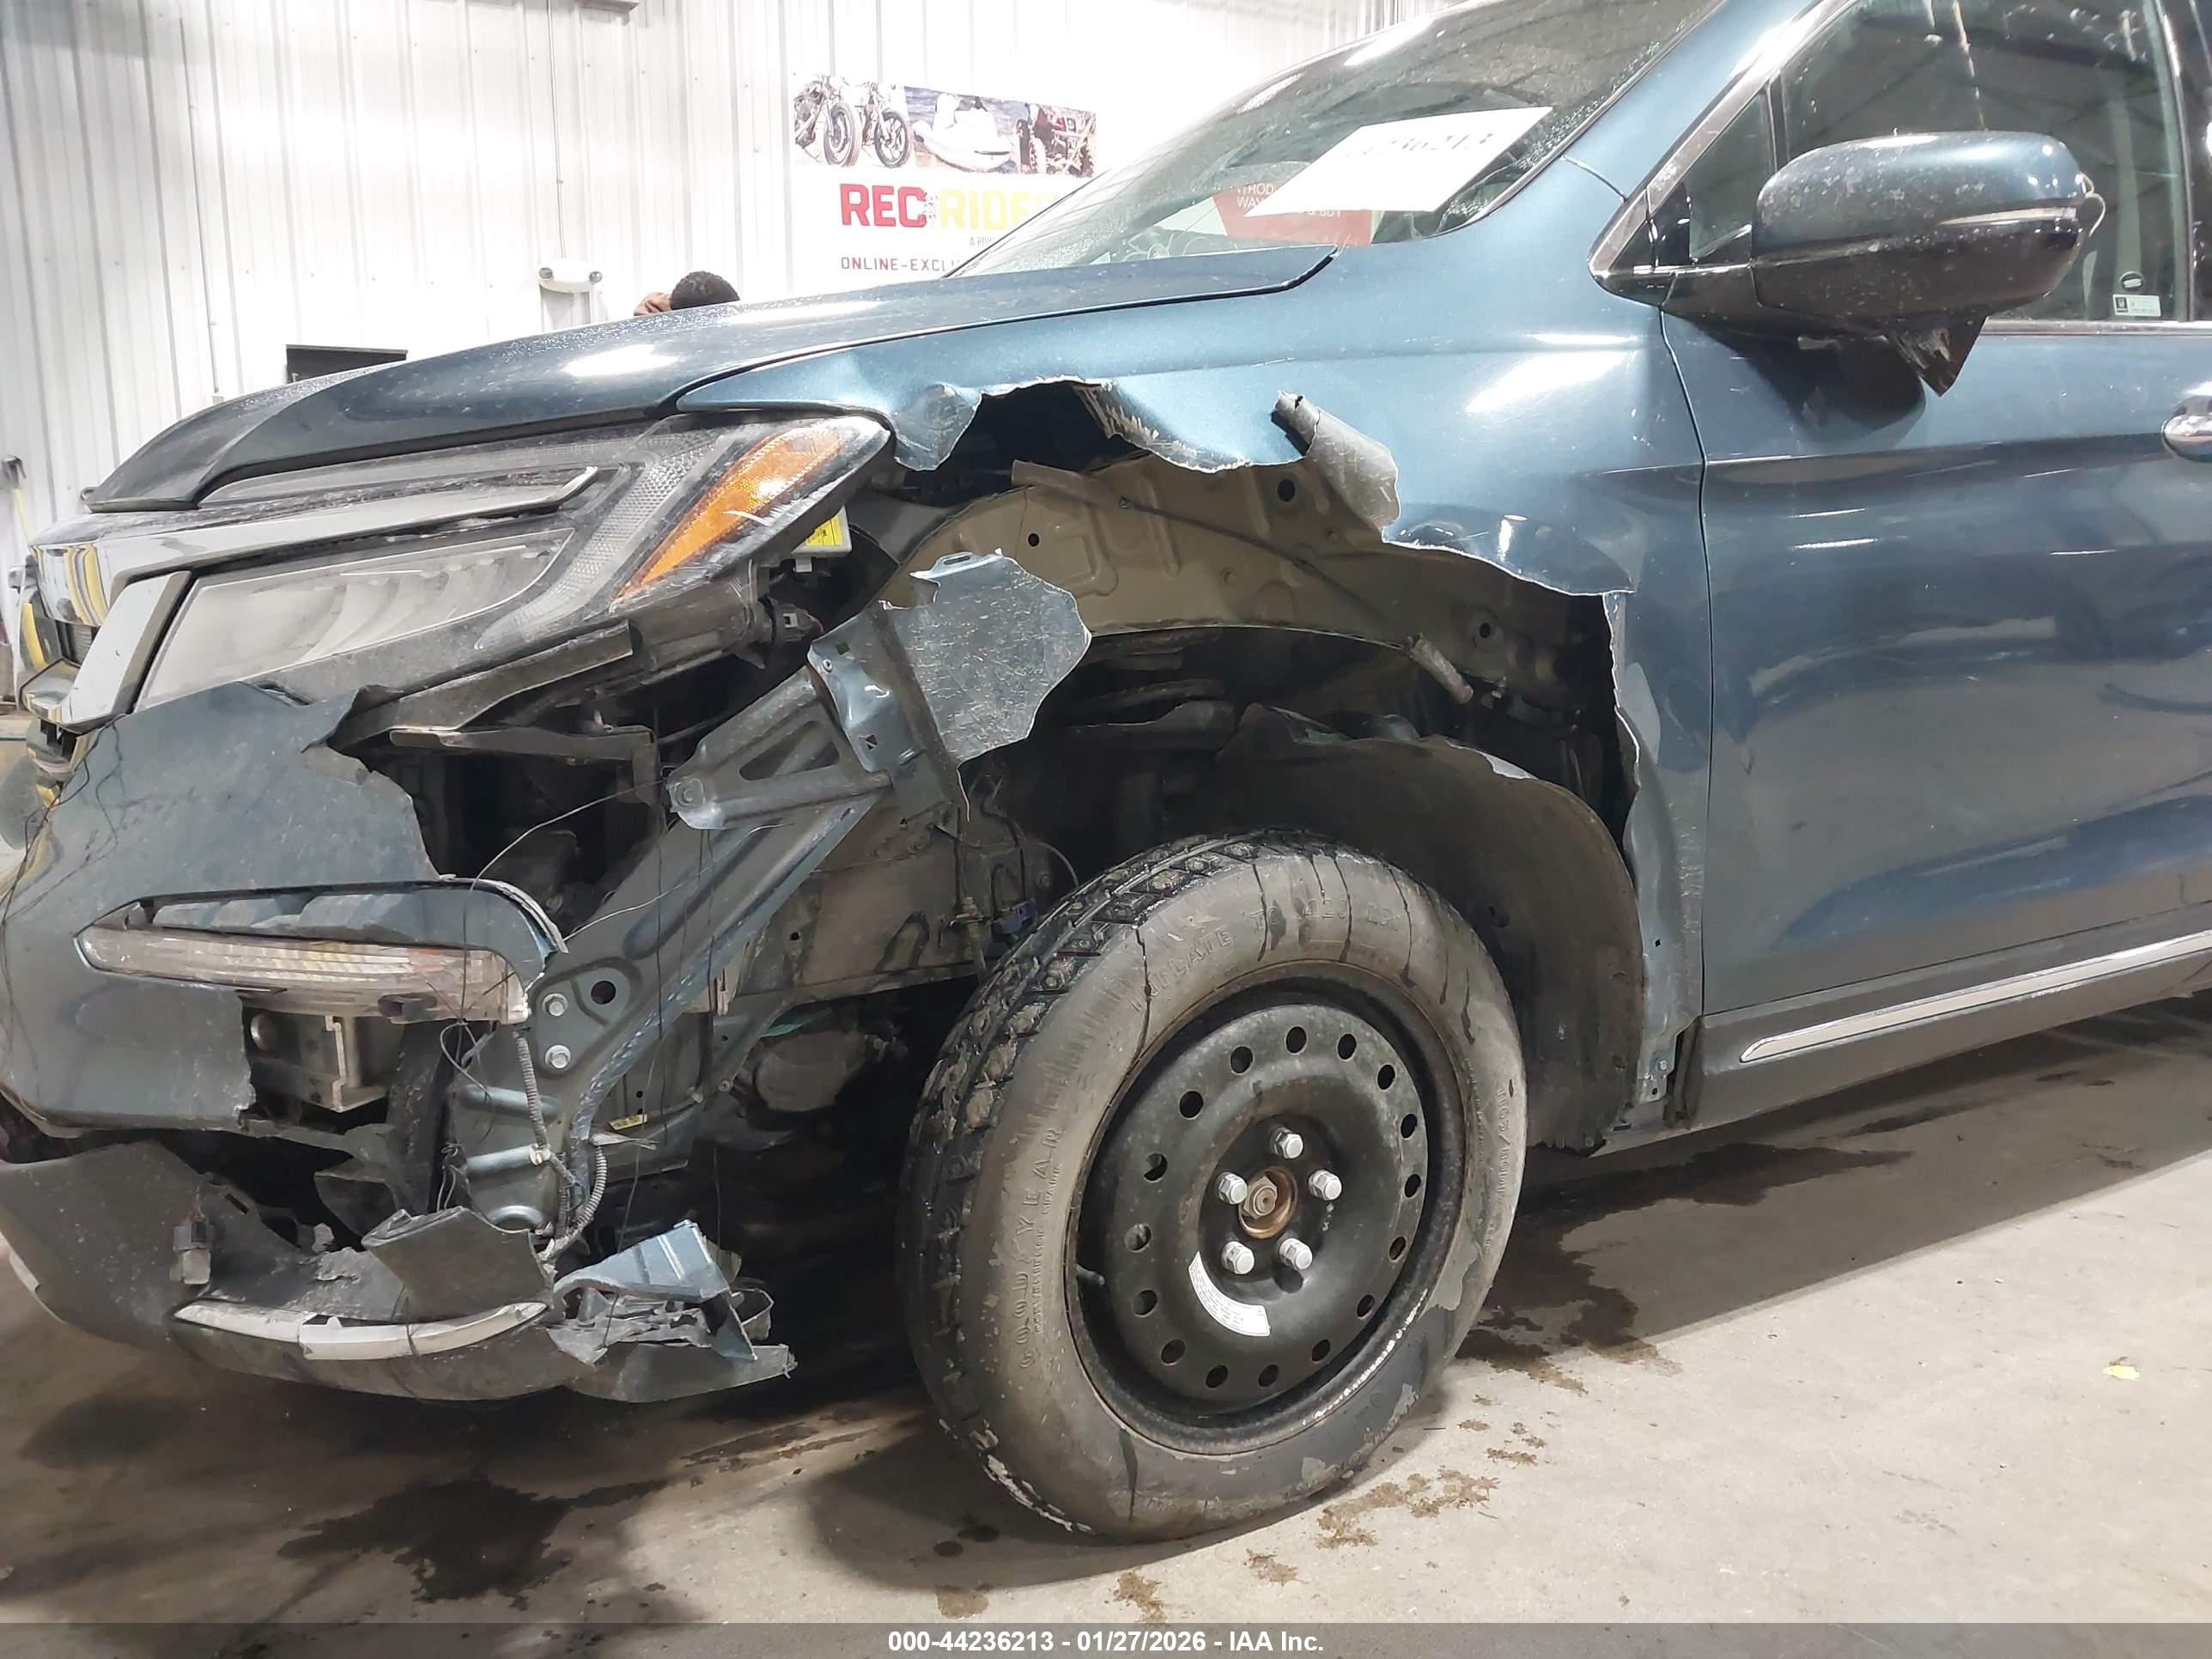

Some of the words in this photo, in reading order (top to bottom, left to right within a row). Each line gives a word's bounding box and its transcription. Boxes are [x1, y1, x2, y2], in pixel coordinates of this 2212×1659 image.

[839, 183, 928, 228] REC
[939, 186, 1060, 231] RIDE
[1128, 924, 1234, 1014] INFLATE
[1250, 905, 1279, 931] TO
[1012, 1127, 1065, 1370] GOODYEAR
